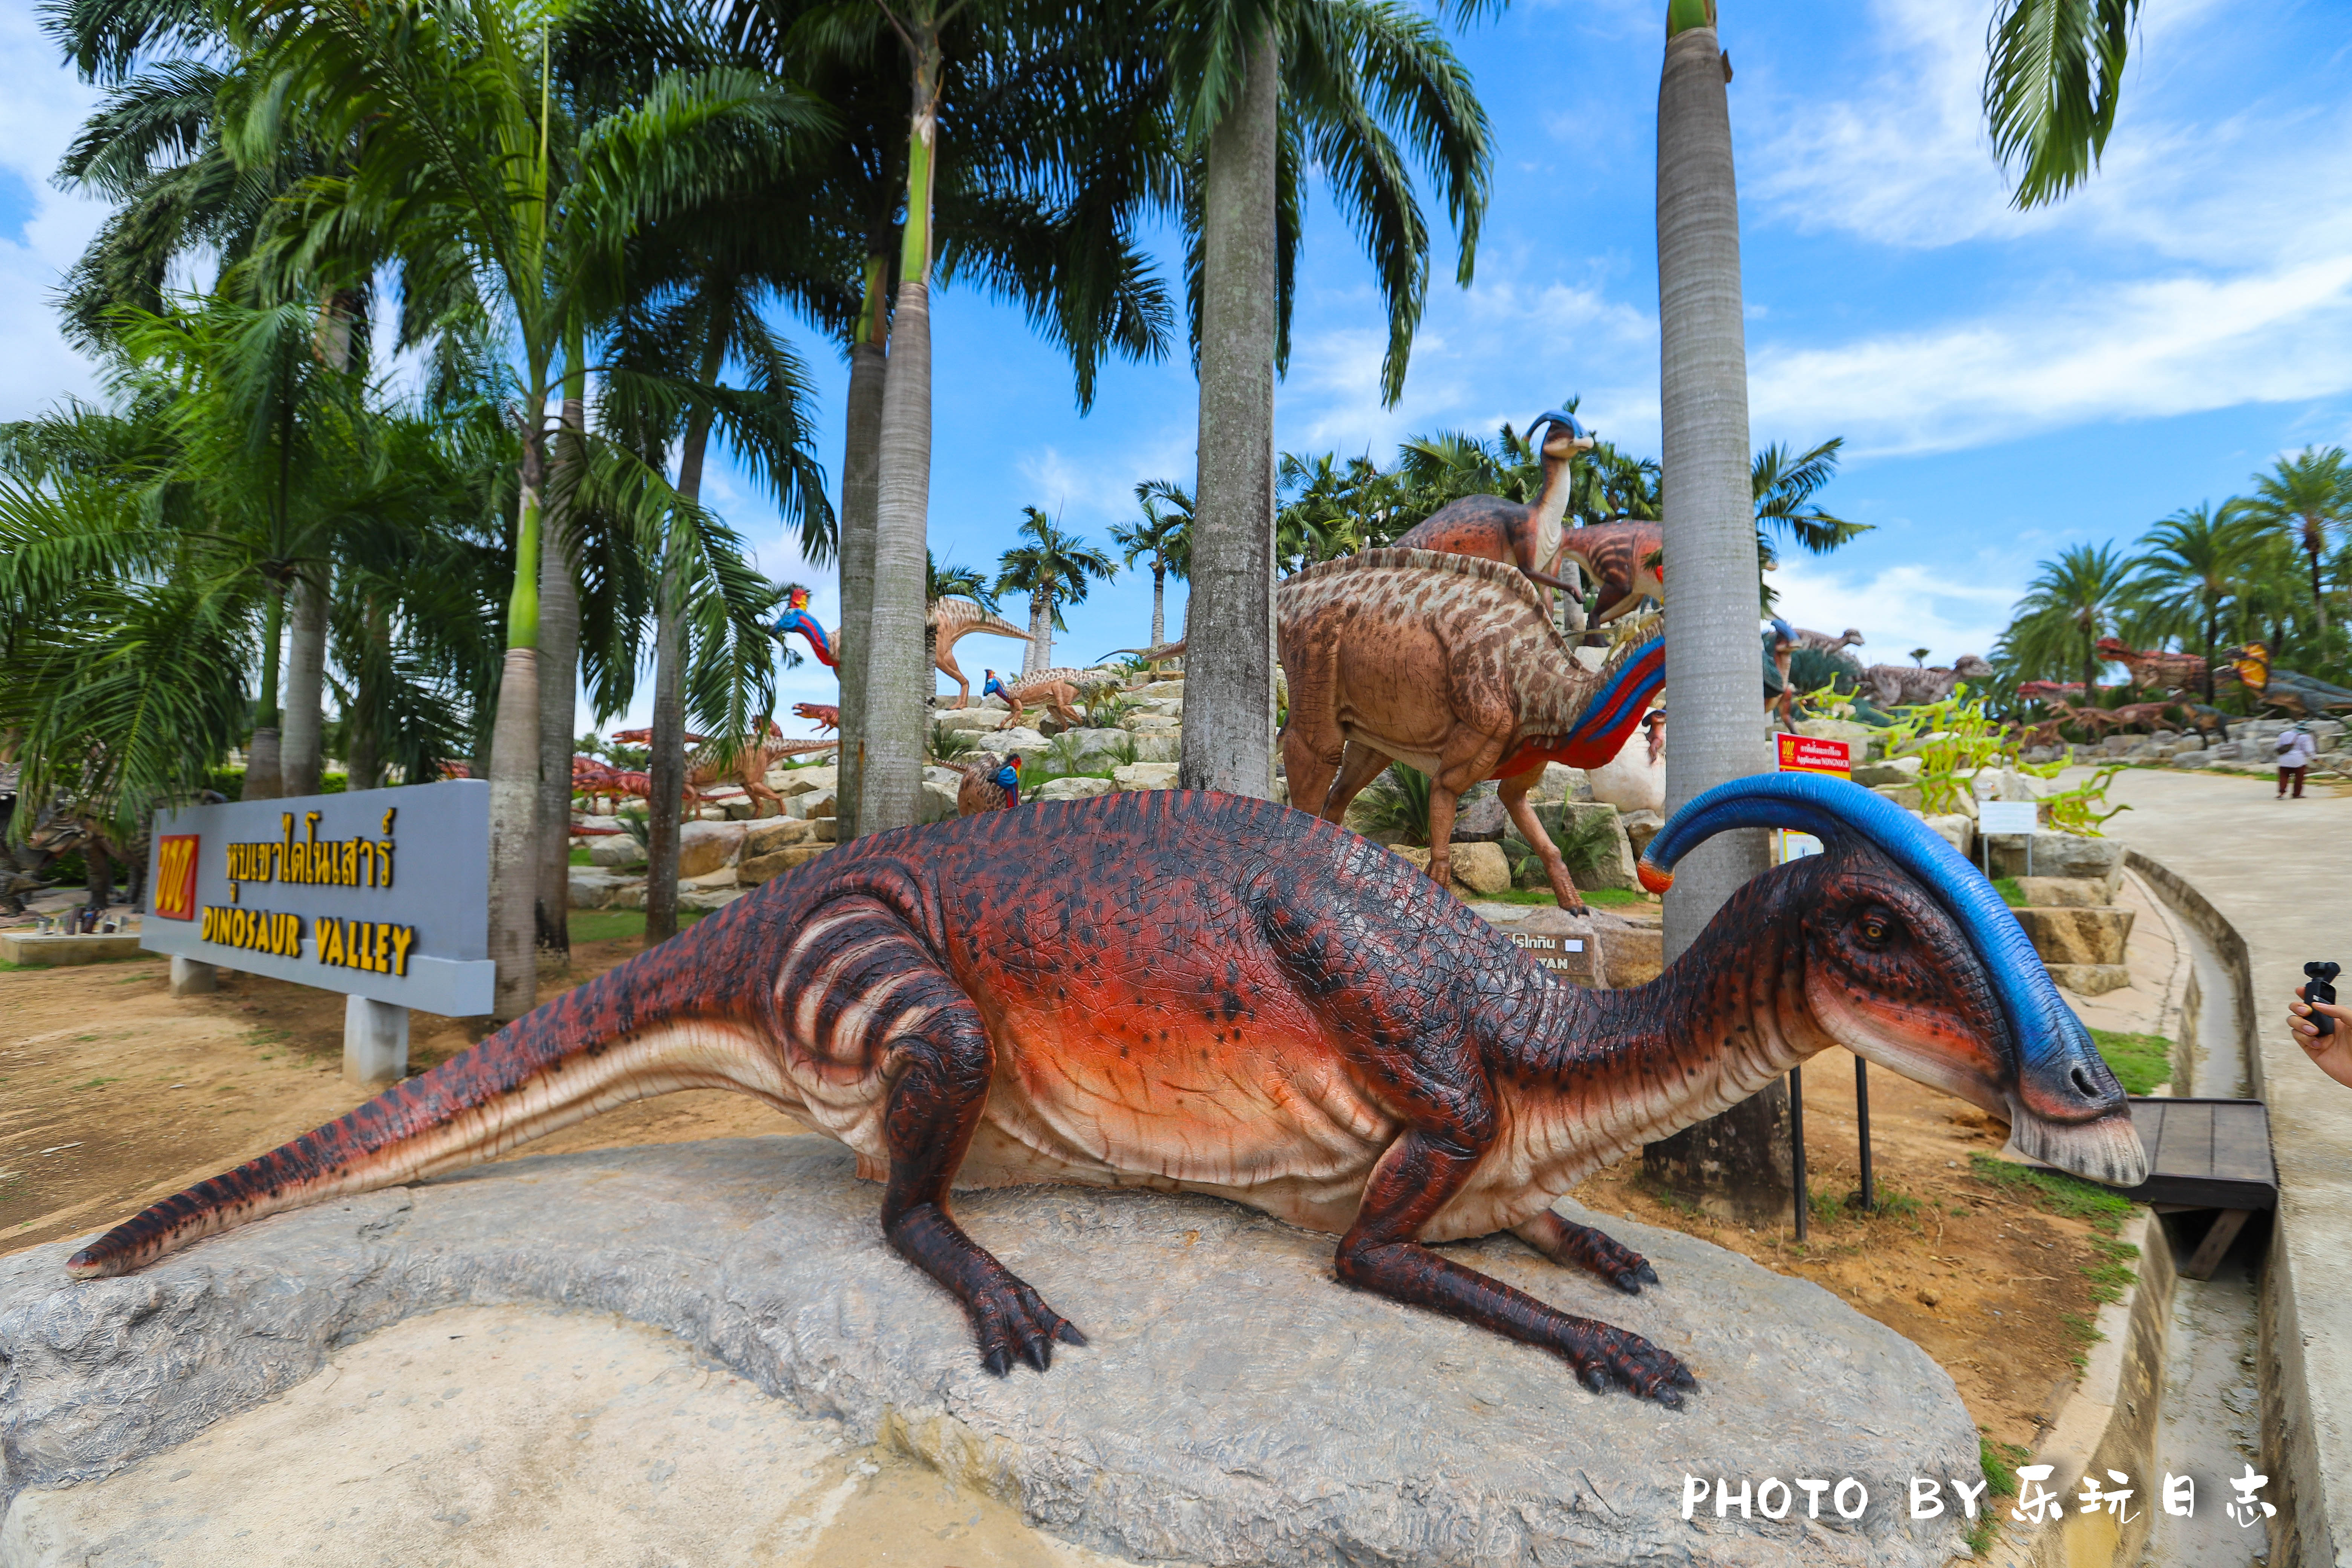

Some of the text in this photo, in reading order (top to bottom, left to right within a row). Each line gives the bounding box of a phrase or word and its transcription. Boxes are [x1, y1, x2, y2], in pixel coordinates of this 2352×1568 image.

[1797, 755, 1821, 765] Application
[226, 808, 394, 902] หุบเขาไดโนเสาร์
[202, 906, 412, 975] DINOSAUR VALLEY
[1536, 957, 1568, 969] TAN
